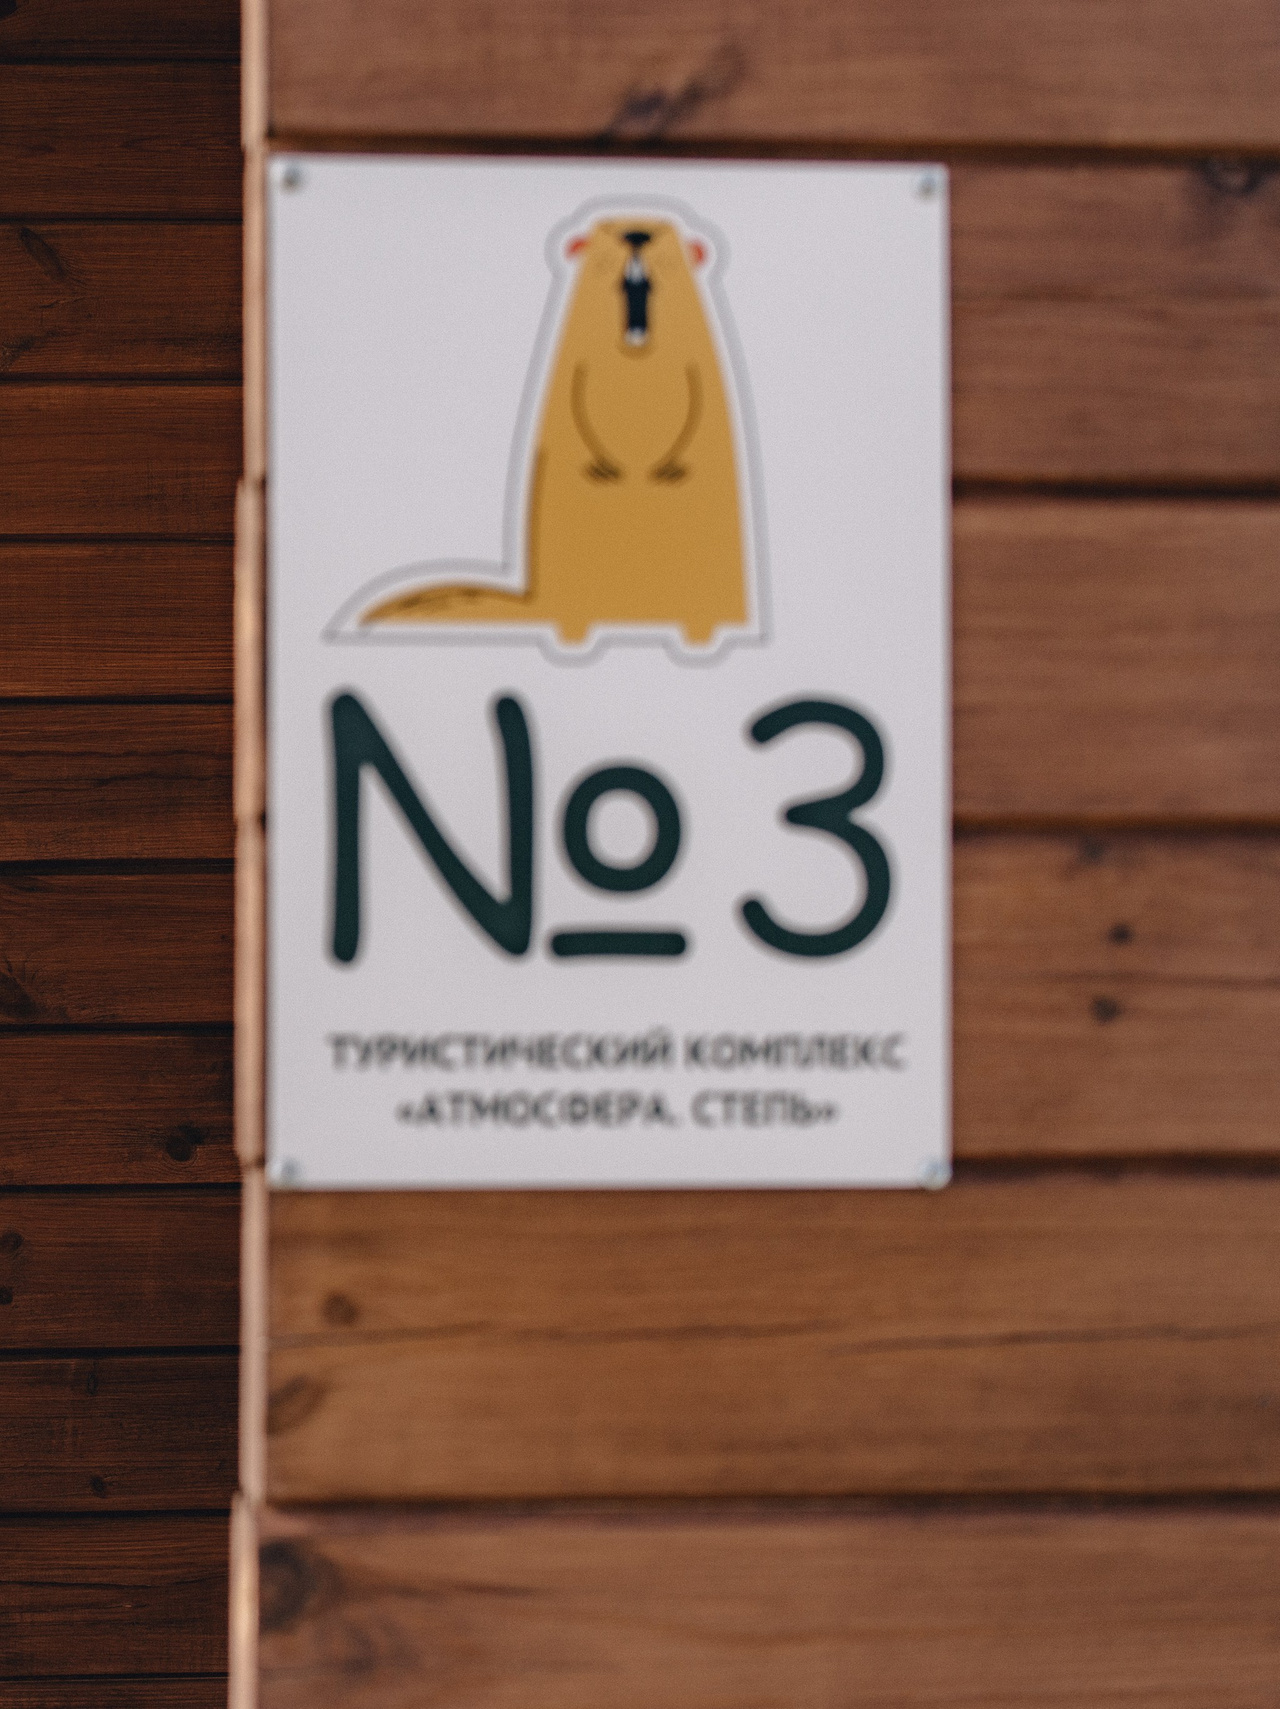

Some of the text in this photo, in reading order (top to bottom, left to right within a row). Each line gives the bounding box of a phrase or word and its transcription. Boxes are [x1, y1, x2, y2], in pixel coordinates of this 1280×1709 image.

[737, 696, 895, 960] 3
[328, 1027, 907, 1070] ТУРИСТИЧЕСКИЙ КОМПЛЕКС
[690, 1090, 838, 1127] СТЕПЬ»
